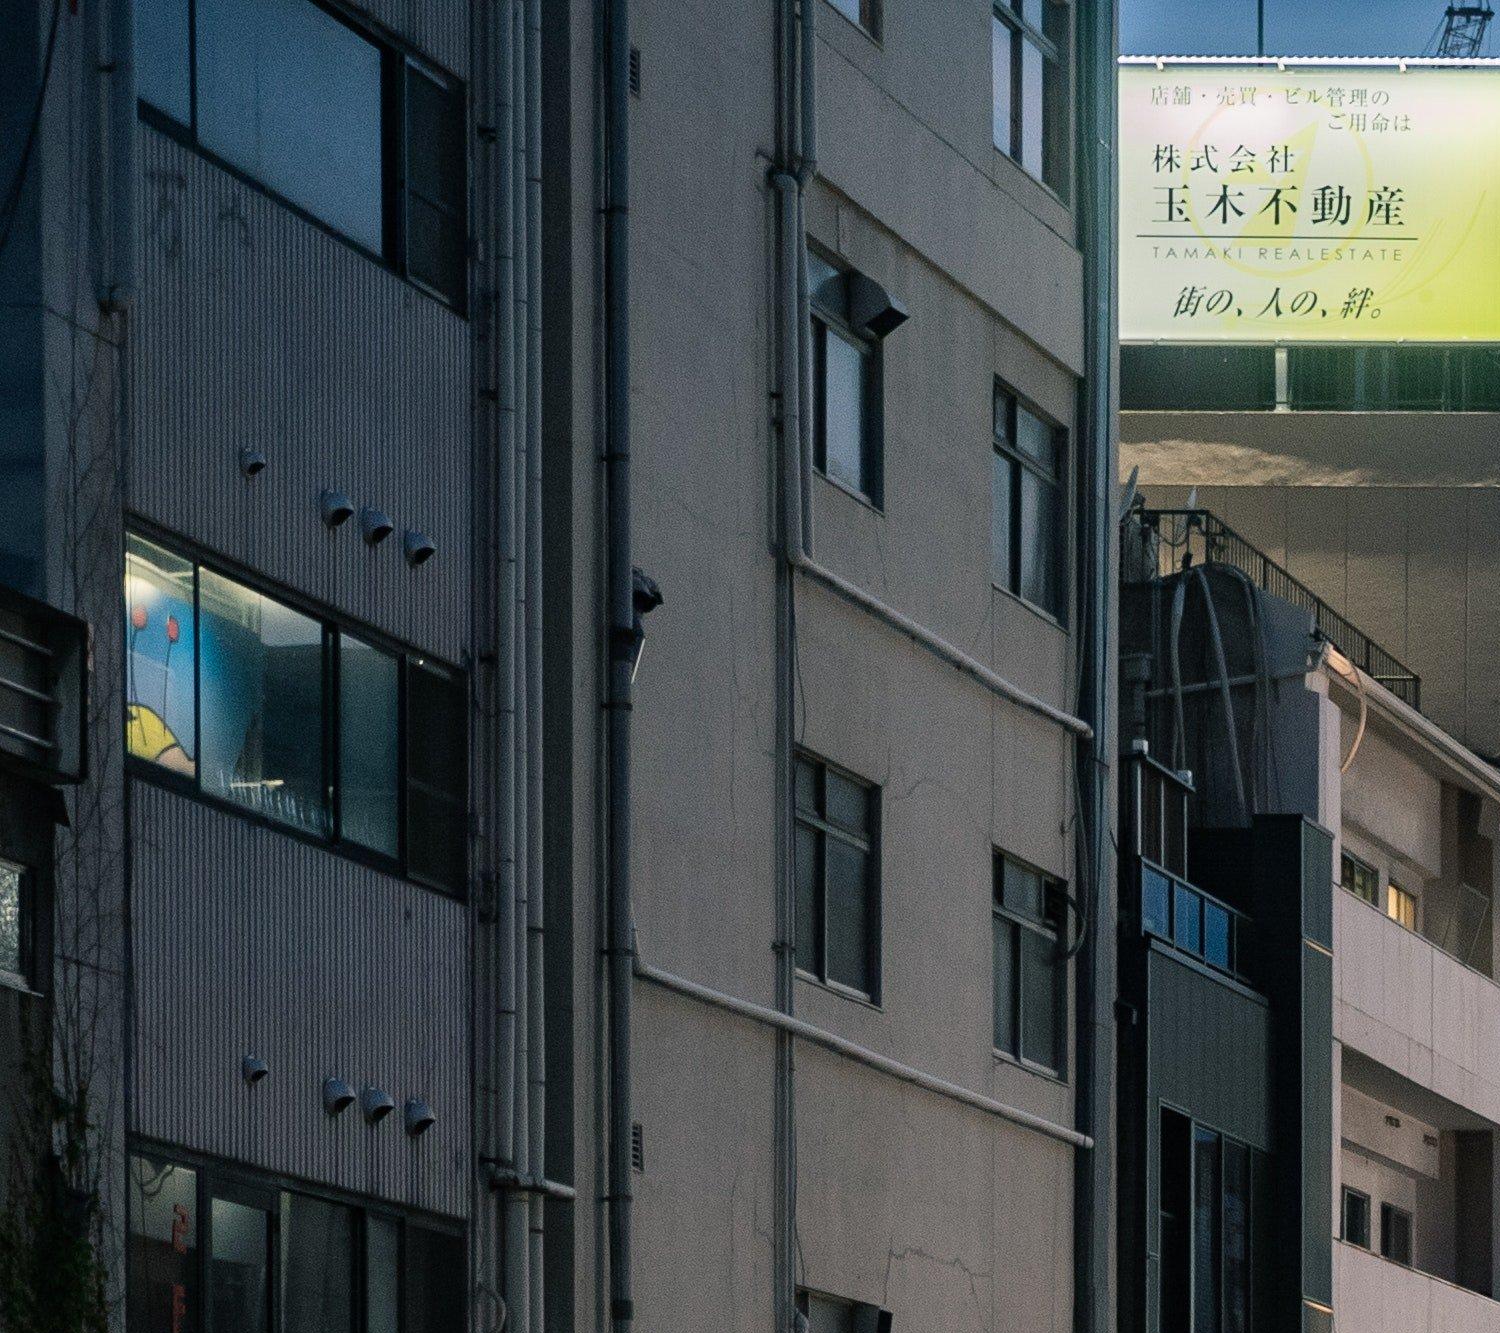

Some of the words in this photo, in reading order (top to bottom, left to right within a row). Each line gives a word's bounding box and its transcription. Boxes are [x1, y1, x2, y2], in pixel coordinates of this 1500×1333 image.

[1328, 112, 1412, 133] ご用命は
[1151, 143, 1297, 175] 株式会社
[1151, 184, 1406, 228] 玉木不動産
[1153, 246, 1245, 260] TAMAKI
[1259, 247, 1403, 262] REALESTATE
